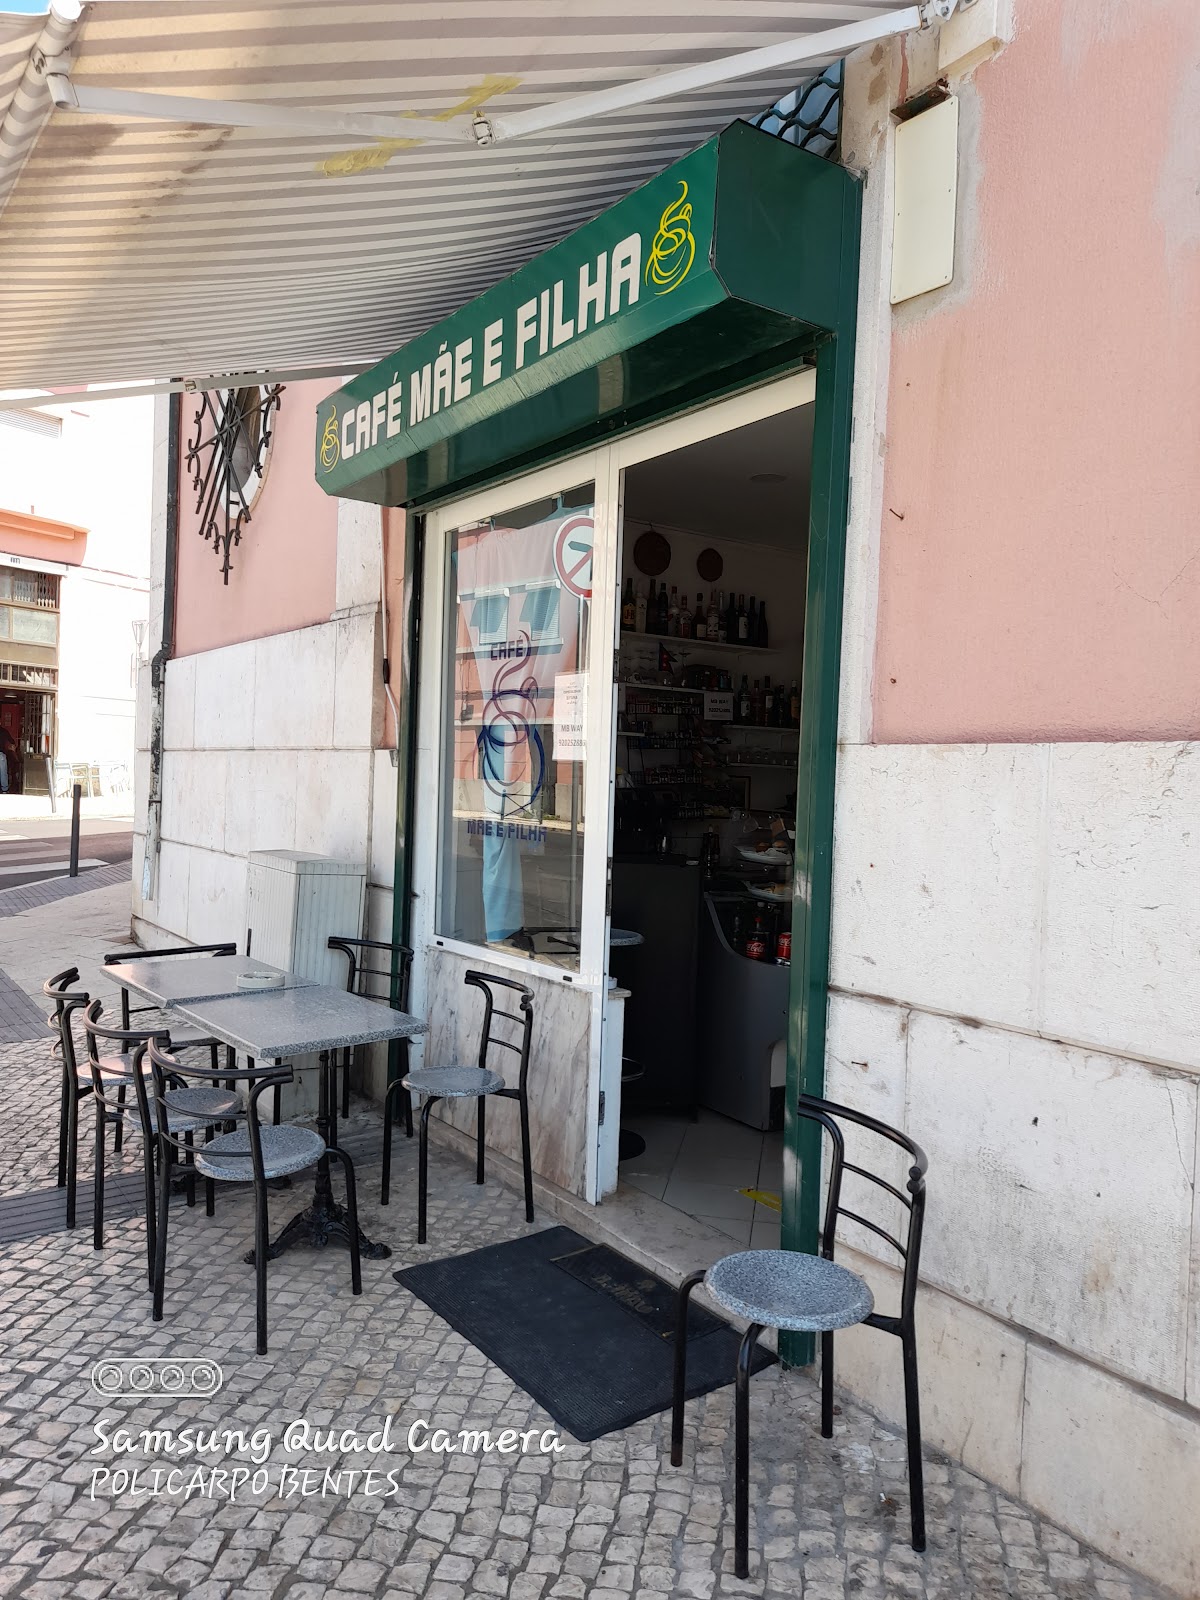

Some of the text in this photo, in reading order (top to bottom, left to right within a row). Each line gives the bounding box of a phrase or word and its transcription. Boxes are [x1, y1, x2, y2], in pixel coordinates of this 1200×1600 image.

[341, 232, 642, 460] CAFÉ MÃE E FILHA
[490, 635, 524, 662] CAFÉ
[495, 820, 504, 838] E
[507, 822, 547, 842] FILHA
